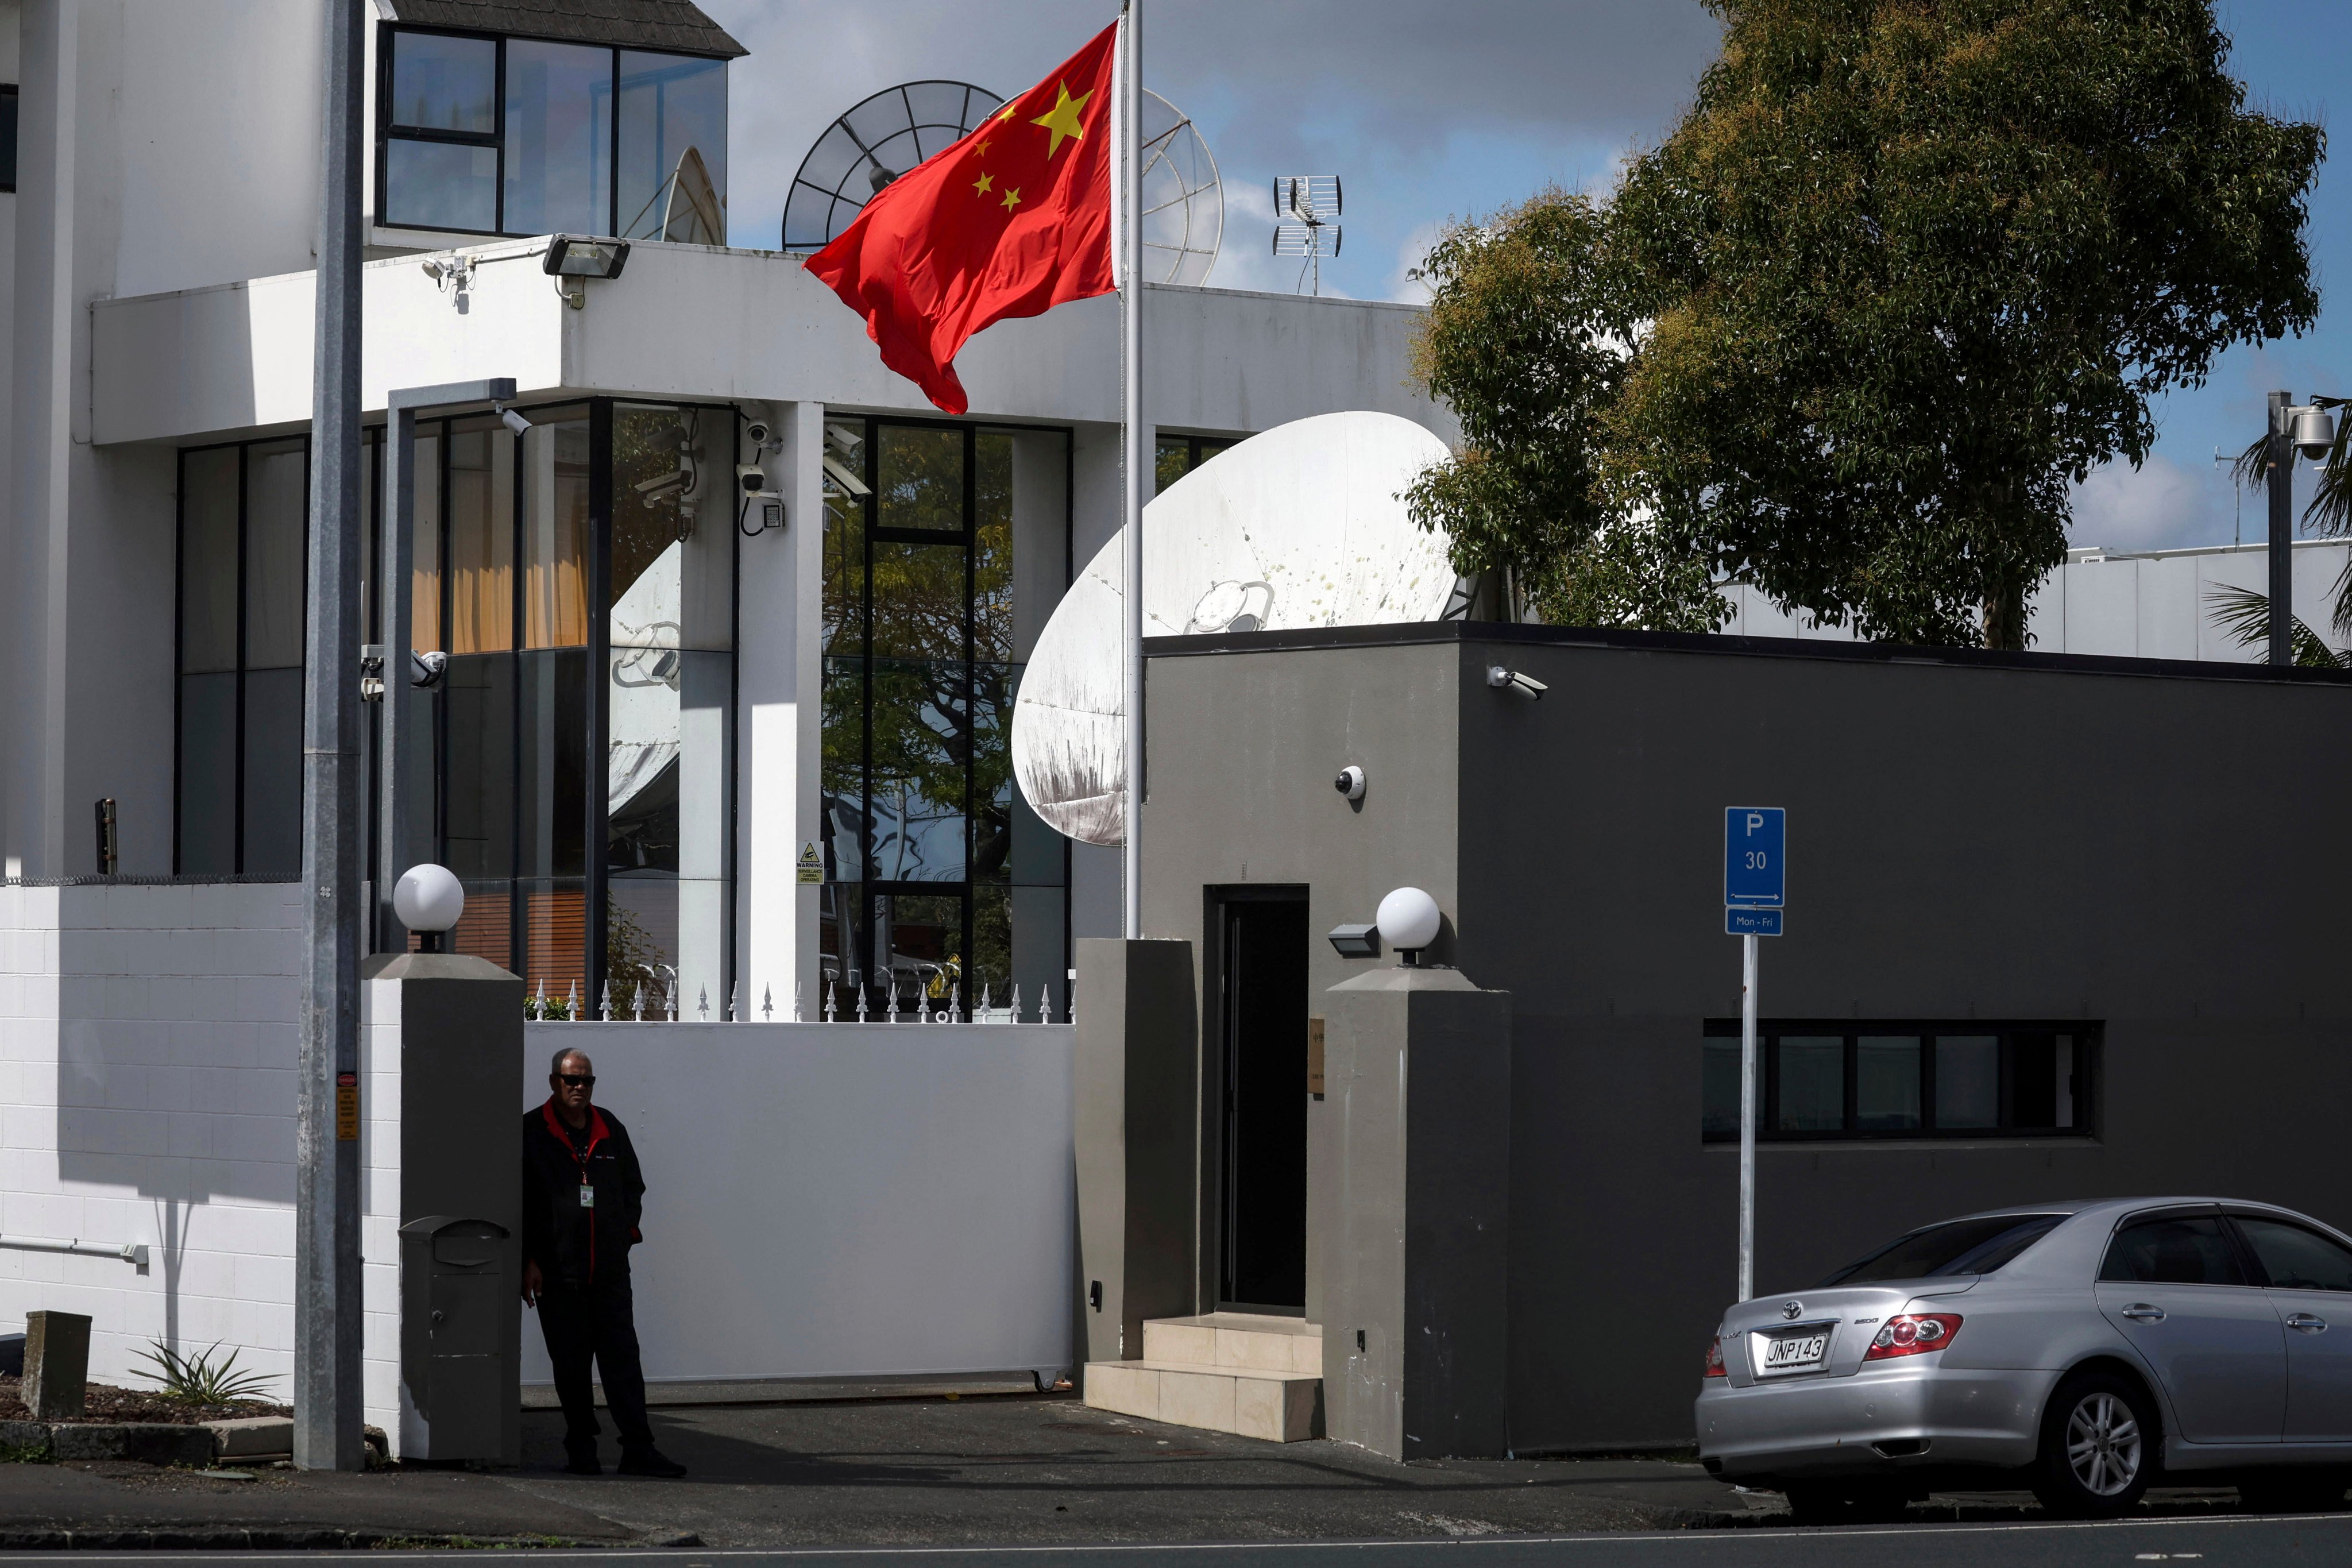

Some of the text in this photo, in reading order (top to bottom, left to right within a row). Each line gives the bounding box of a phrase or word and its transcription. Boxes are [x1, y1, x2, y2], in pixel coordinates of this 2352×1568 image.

[1747, 813, 1764, 837] P
[1745, 851, 1767, 870] 30
[1736, 917, 1755, 926] Mon
[1762, 917, 1773, 927] Fri
[1768, 1340, 1822, 1361] JNP143
